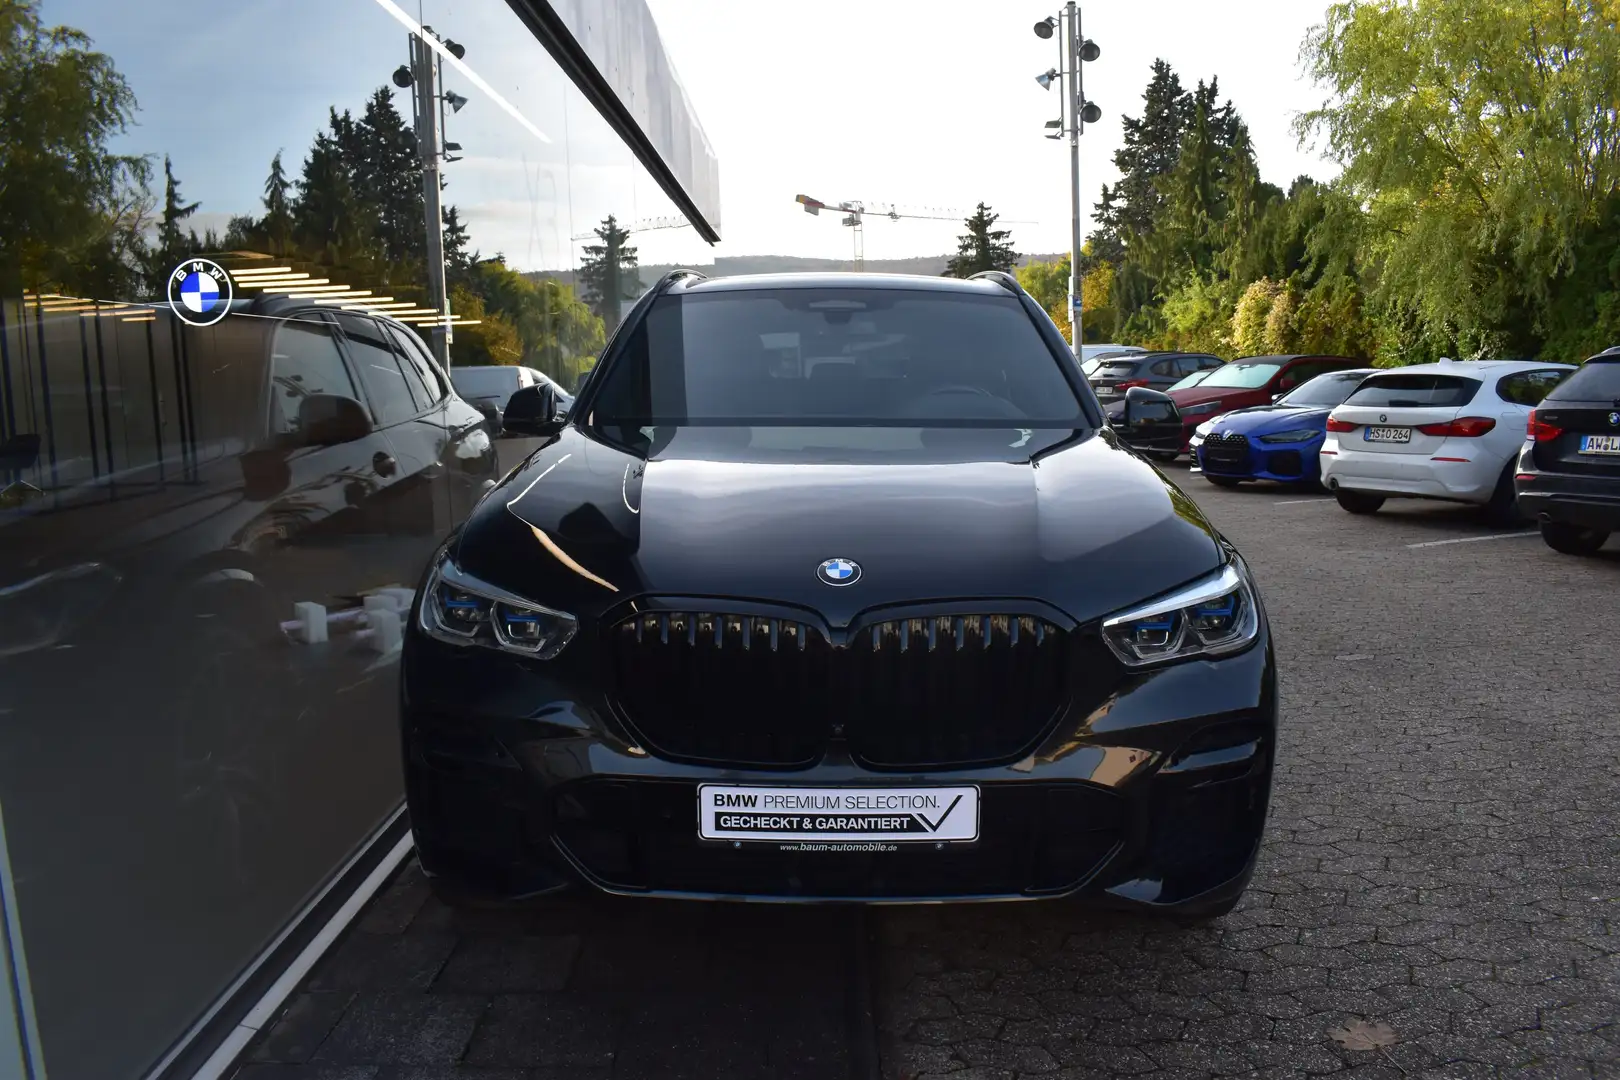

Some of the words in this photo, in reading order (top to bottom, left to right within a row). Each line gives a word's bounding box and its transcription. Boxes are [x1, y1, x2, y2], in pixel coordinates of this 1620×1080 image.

[175, 262, 223, 282] BMW
[1370, 428, 1380, 439] HS
[1392, 429, 1409, 440] 264
[1587, 437, 1604, 450] AW
[713, 793, 758, 807] BMW
[764, 795, 840, 809] PREMIUM
[845, 795, 941, 809] SELECTION.
[719, 815, 800, 829] GECHECKT
[802, 816, 813, 829] &
[815, 816, 910, 829] GARANTIERT
[779, 841, 898, 852] www.baum-automobile.de
